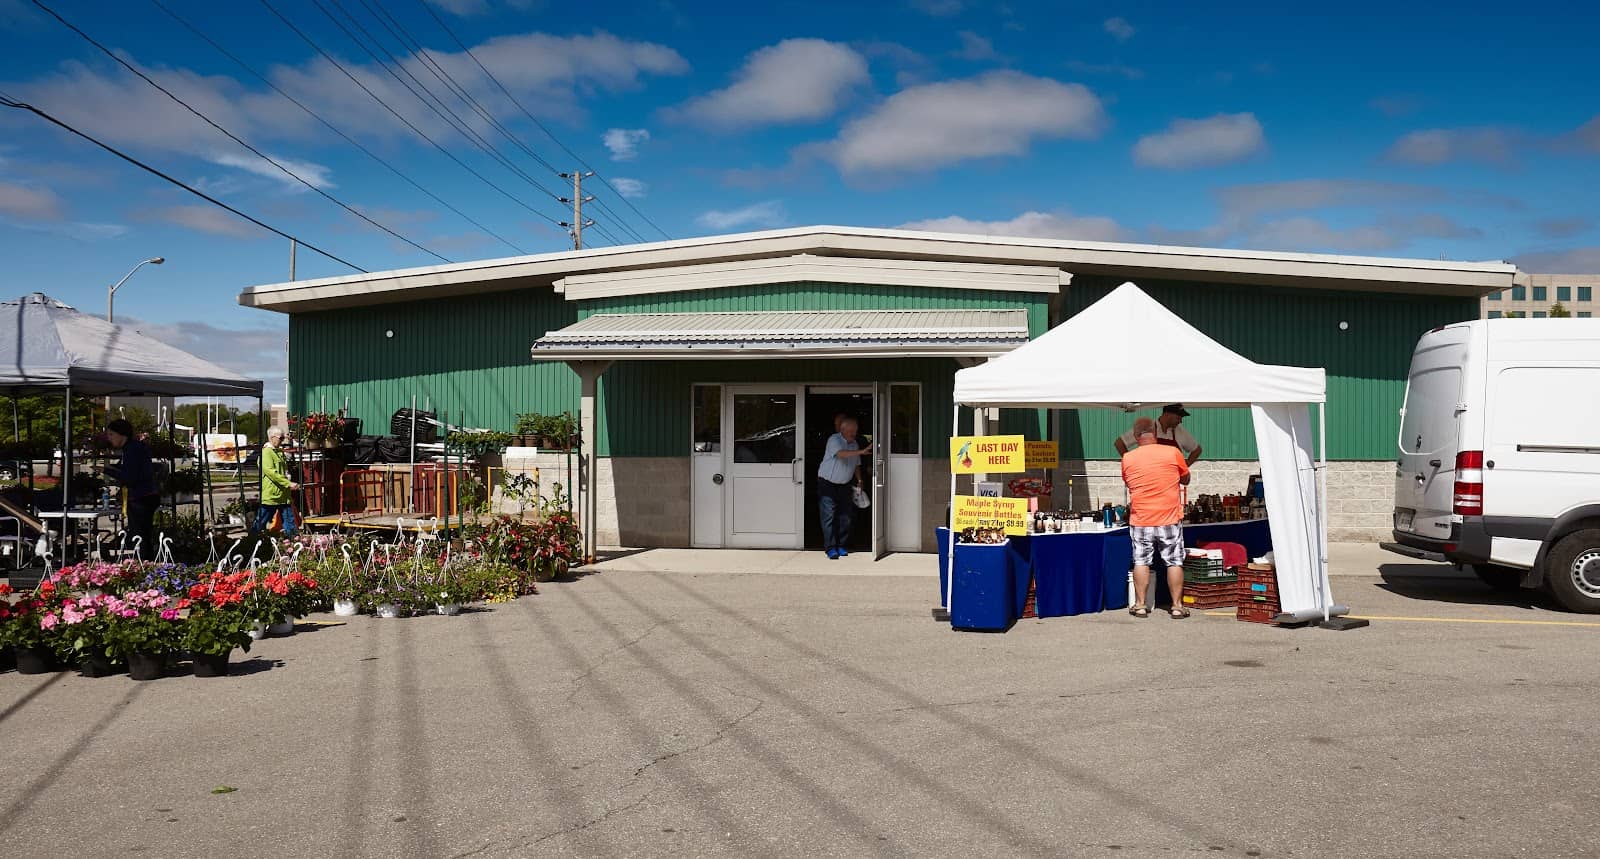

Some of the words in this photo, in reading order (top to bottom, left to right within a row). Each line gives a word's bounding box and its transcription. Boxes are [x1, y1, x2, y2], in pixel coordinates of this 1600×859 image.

[976, 443, 999, 453] LAST
[1001, 442, 1019, 452] DAY
[988, 455, 1011, 465] HERE
[966, 498, 991, 508] Maple
[993, 500, 1015, 510] Syrup
[958, 508, 992, 518] Souvenir
[994, 509, 1022, 519] Bottles
[996, 519, 1005, 527] for
